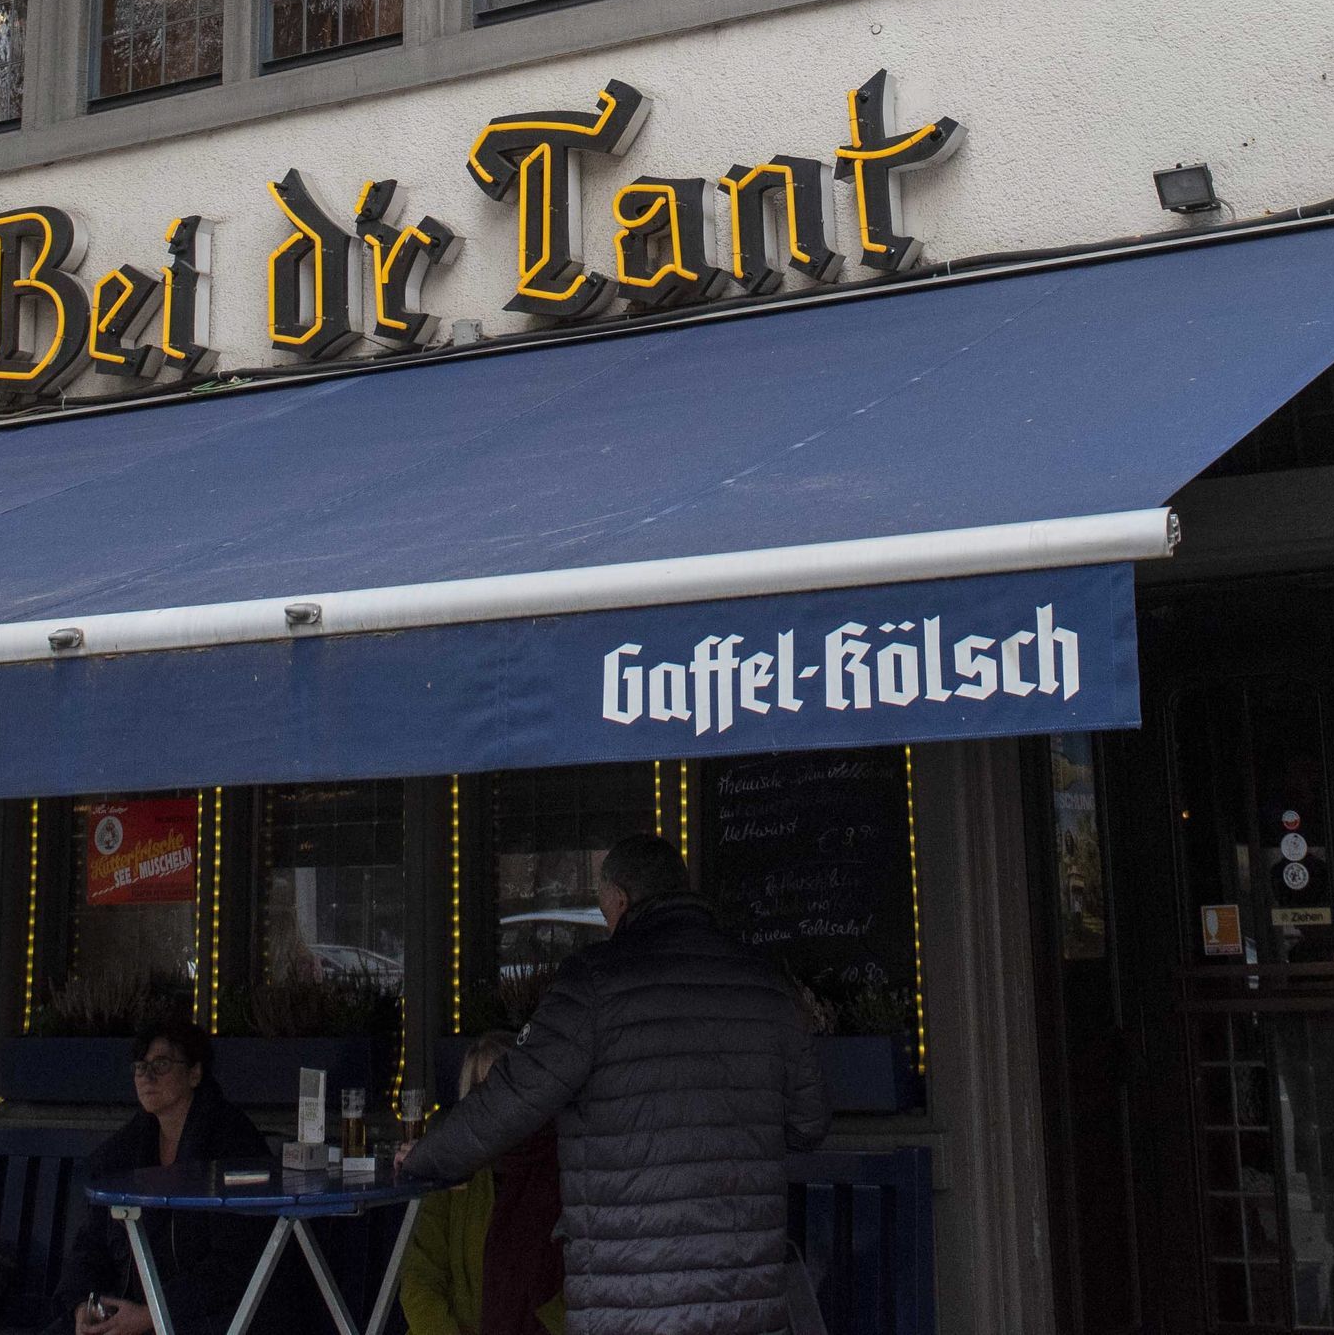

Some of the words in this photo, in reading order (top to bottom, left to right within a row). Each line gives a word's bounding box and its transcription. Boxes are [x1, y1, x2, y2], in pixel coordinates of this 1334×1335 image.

[467, 69, 970, 321] Tant
[113, 866, 132, 888] SEE
[138, 846, 193, 880] MUSCHELN
[798, 913, 874, 938] Feldsalat
[1291, 912, 1324, 922] Ziehen
